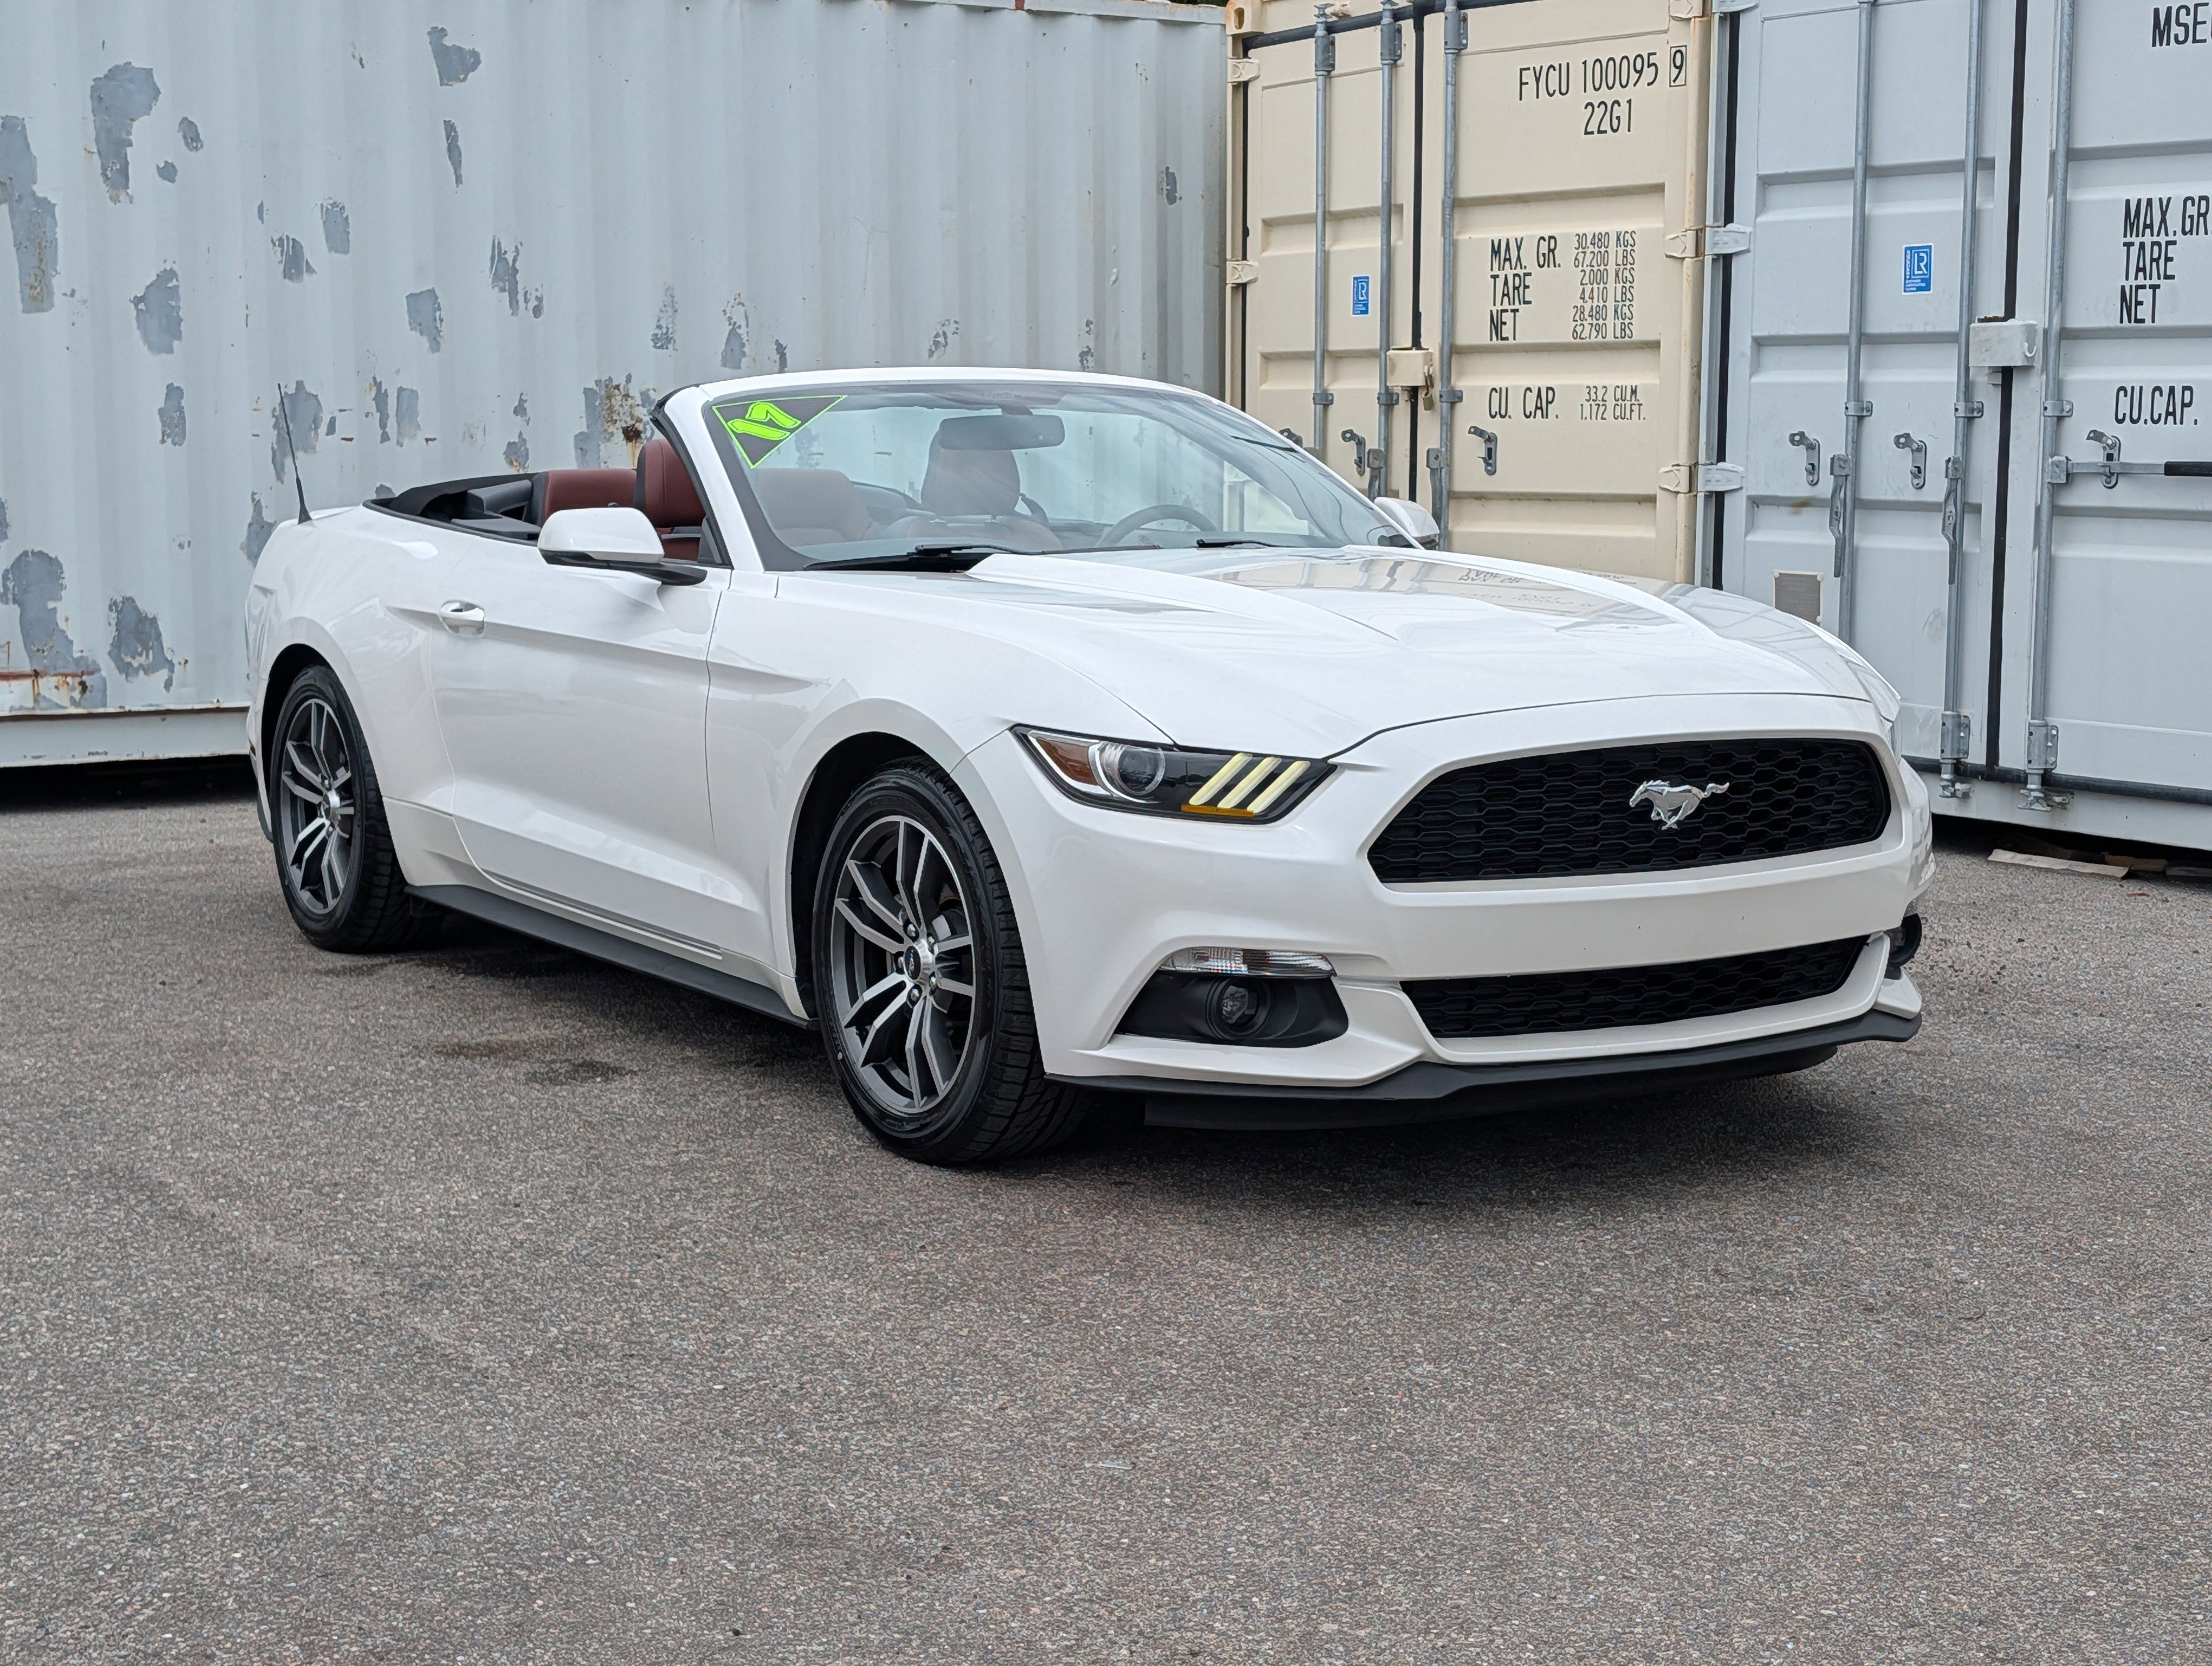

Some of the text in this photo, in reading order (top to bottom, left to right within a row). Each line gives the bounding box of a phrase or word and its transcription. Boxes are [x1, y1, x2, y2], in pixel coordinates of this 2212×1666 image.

[2152, 2, 2212, 47] MSE
[1519, 49, 1684, 101] FYCU 100095 9
[1584, 98, 1632, 135] 22G1
[2123, 195, 2212, 238] MAX.GR
[1491, 235, 1561, 271] MAX. GR.
[1574, 230, 1636, 250] 30.480 KGS
[1574, 249, 1635, 268] 67.200 LBS
[1914, 252, 1927, 274] LR
[2123, 240, 2177, 281] TARE
[1490, 272, 1532, 306] TARE
[1615, 267, 1635, 285] KGS
[1614, 286, 1635, 303] LBS
[2119, 284, 2161, 324] NET
[1489, 309, 1519, 341] NET
[1572, 304, 1634, 322] 28.480 KGS
[1572, 322, 1634, 340] 62.790 LBS
[1489, 386, 1559, 419] CU. CAP.
[1585, 386, 1608, 402] 33.2
